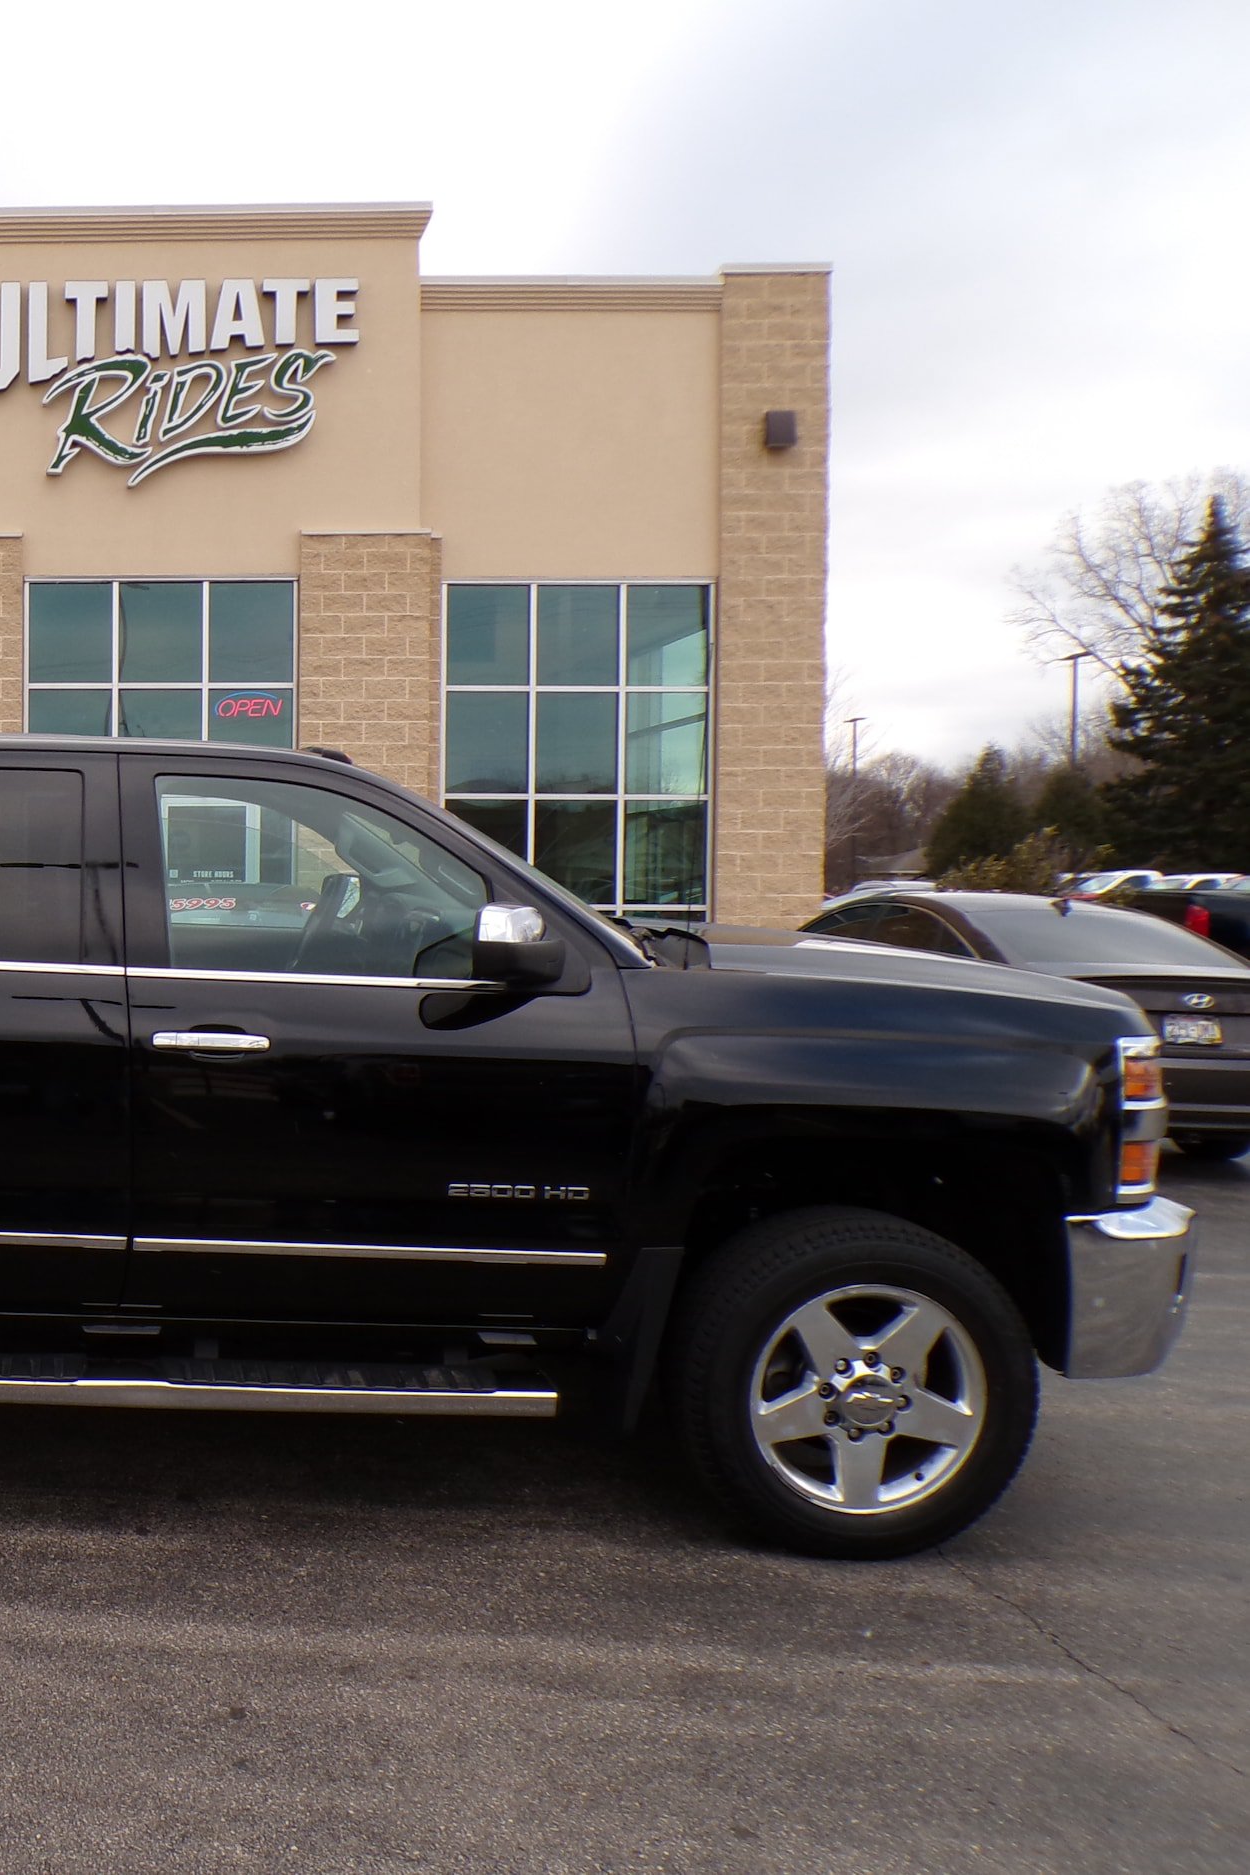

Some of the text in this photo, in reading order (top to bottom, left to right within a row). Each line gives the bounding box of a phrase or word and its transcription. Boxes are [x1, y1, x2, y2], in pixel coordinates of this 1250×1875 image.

[218, 698, 283, 717] OPEN
[169, 897, 236, 911] 5995
[447, 1184, 590, 1200] 2500 HD
